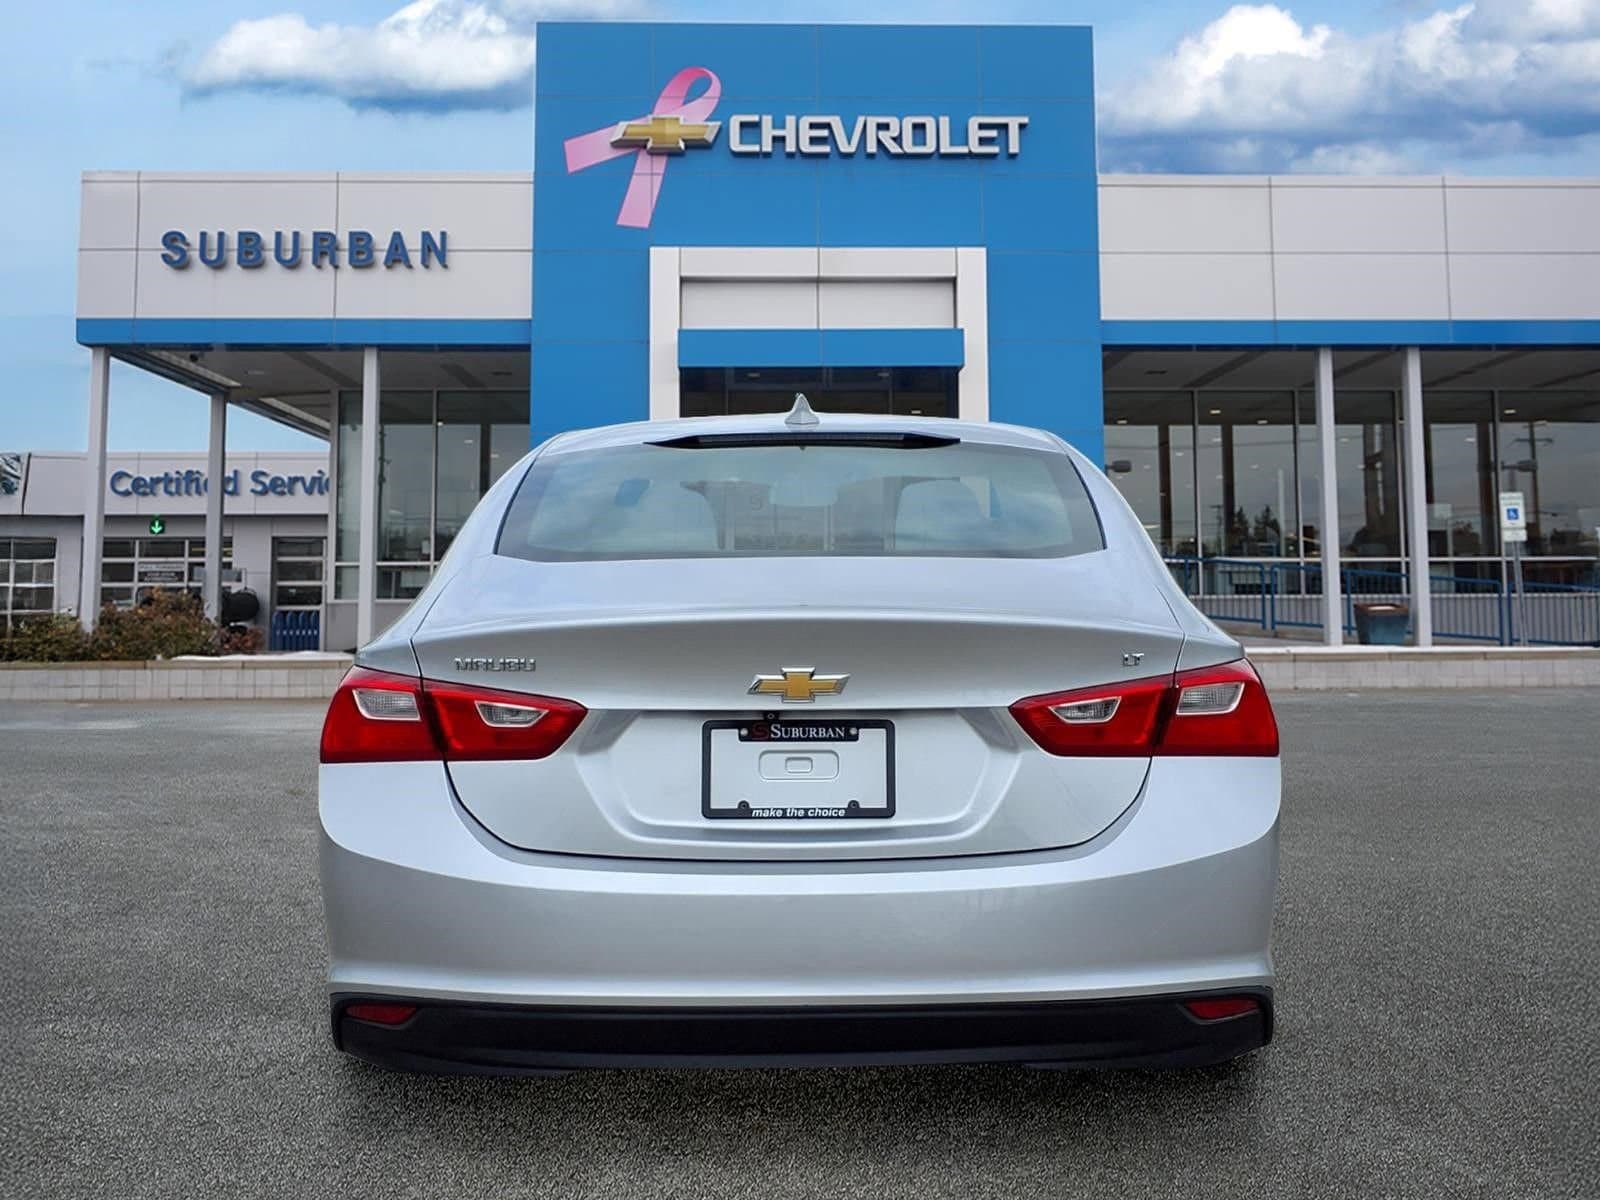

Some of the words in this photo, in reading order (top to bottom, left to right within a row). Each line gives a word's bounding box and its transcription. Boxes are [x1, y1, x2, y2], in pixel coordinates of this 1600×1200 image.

[728, 114, 1029, 158] CHEVROLET
[161, 229, 449, 270] SUBURBAN
[454, 657, 536, 672] MALIBU
[752, 808, 783, 817] make
[786, 807, 805, 817] the
[807, 807, 846, 817] choice
